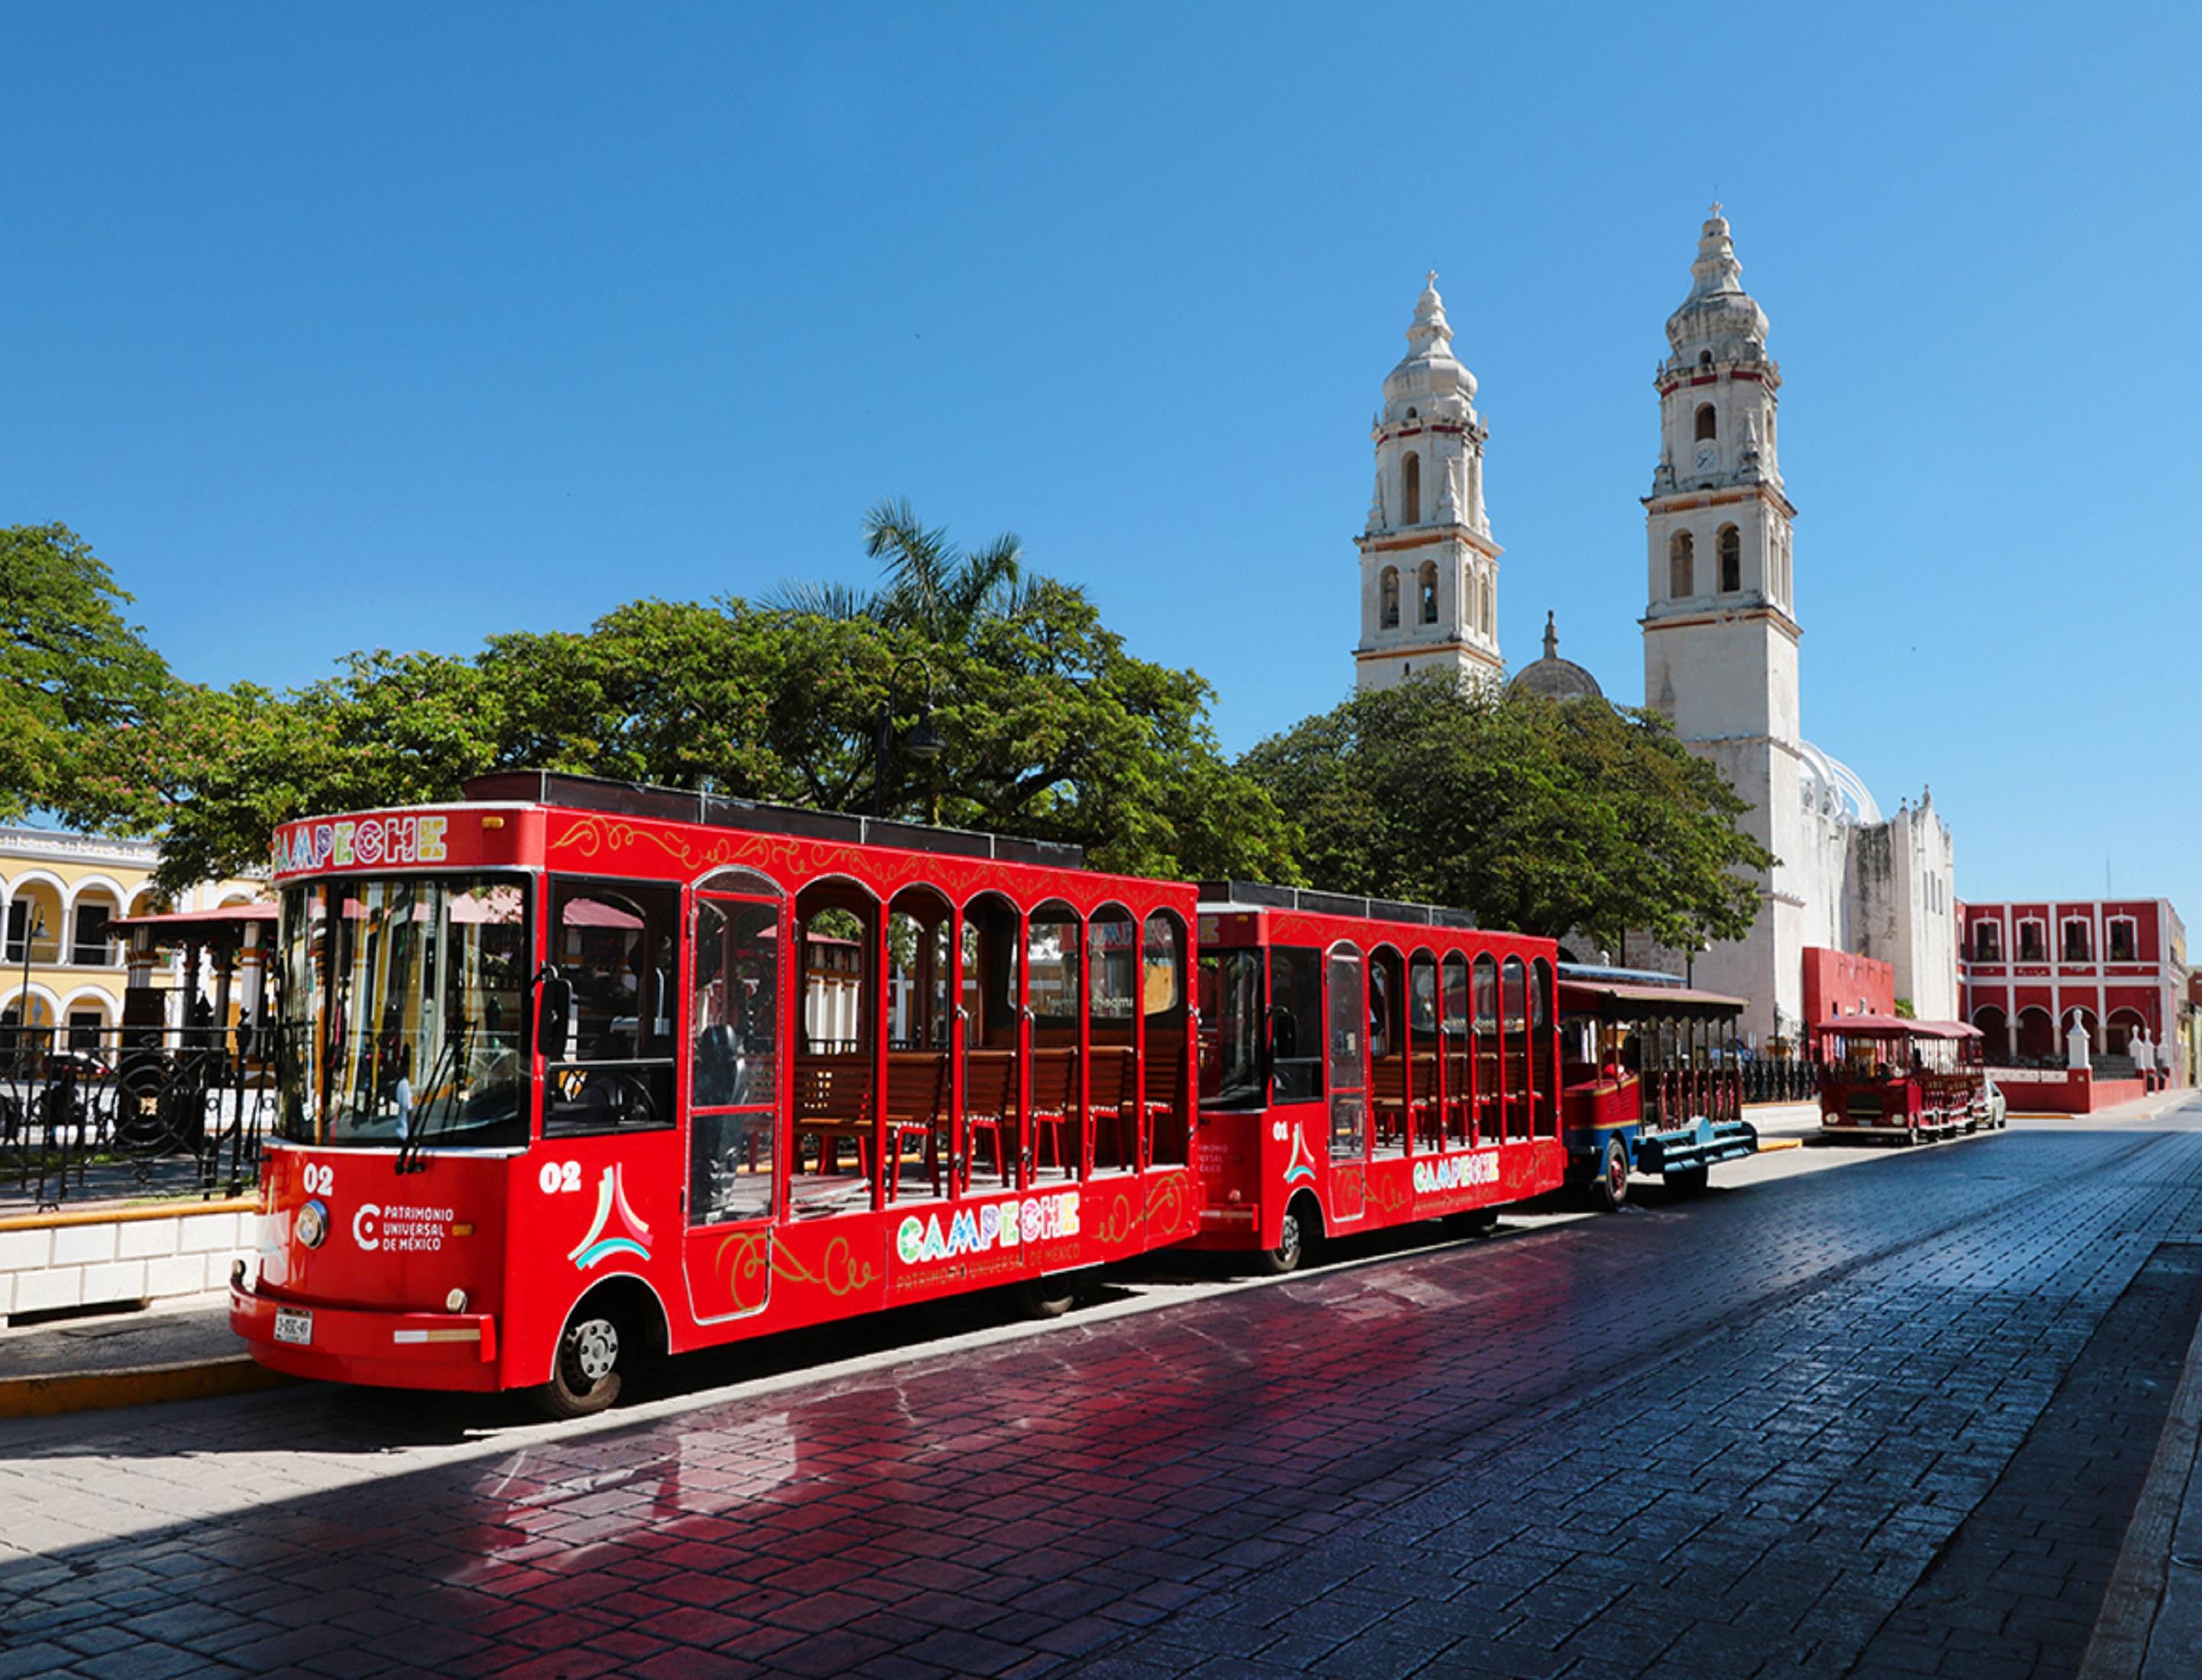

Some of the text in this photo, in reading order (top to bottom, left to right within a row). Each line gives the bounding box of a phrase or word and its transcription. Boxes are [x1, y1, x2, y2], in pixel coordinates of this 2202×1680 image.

[273, 817, 447, 872] CAMPECHE
[1273, 1121, 1288, 1141] 01
[303, 1162, 333, 1196] 02
[539, 1160, 581, 1194] 02
[1413, 1152, 1499, 1194] CAMPECHE
[383, 1221, 445, 1237] UNIVERSAL
[384, 1204, 454, 1222] PATRIMONIO
[897, 1191, 1080, 1265] CAMPECHE
[382, 1236, 441, 1251] DE MÉXICO
